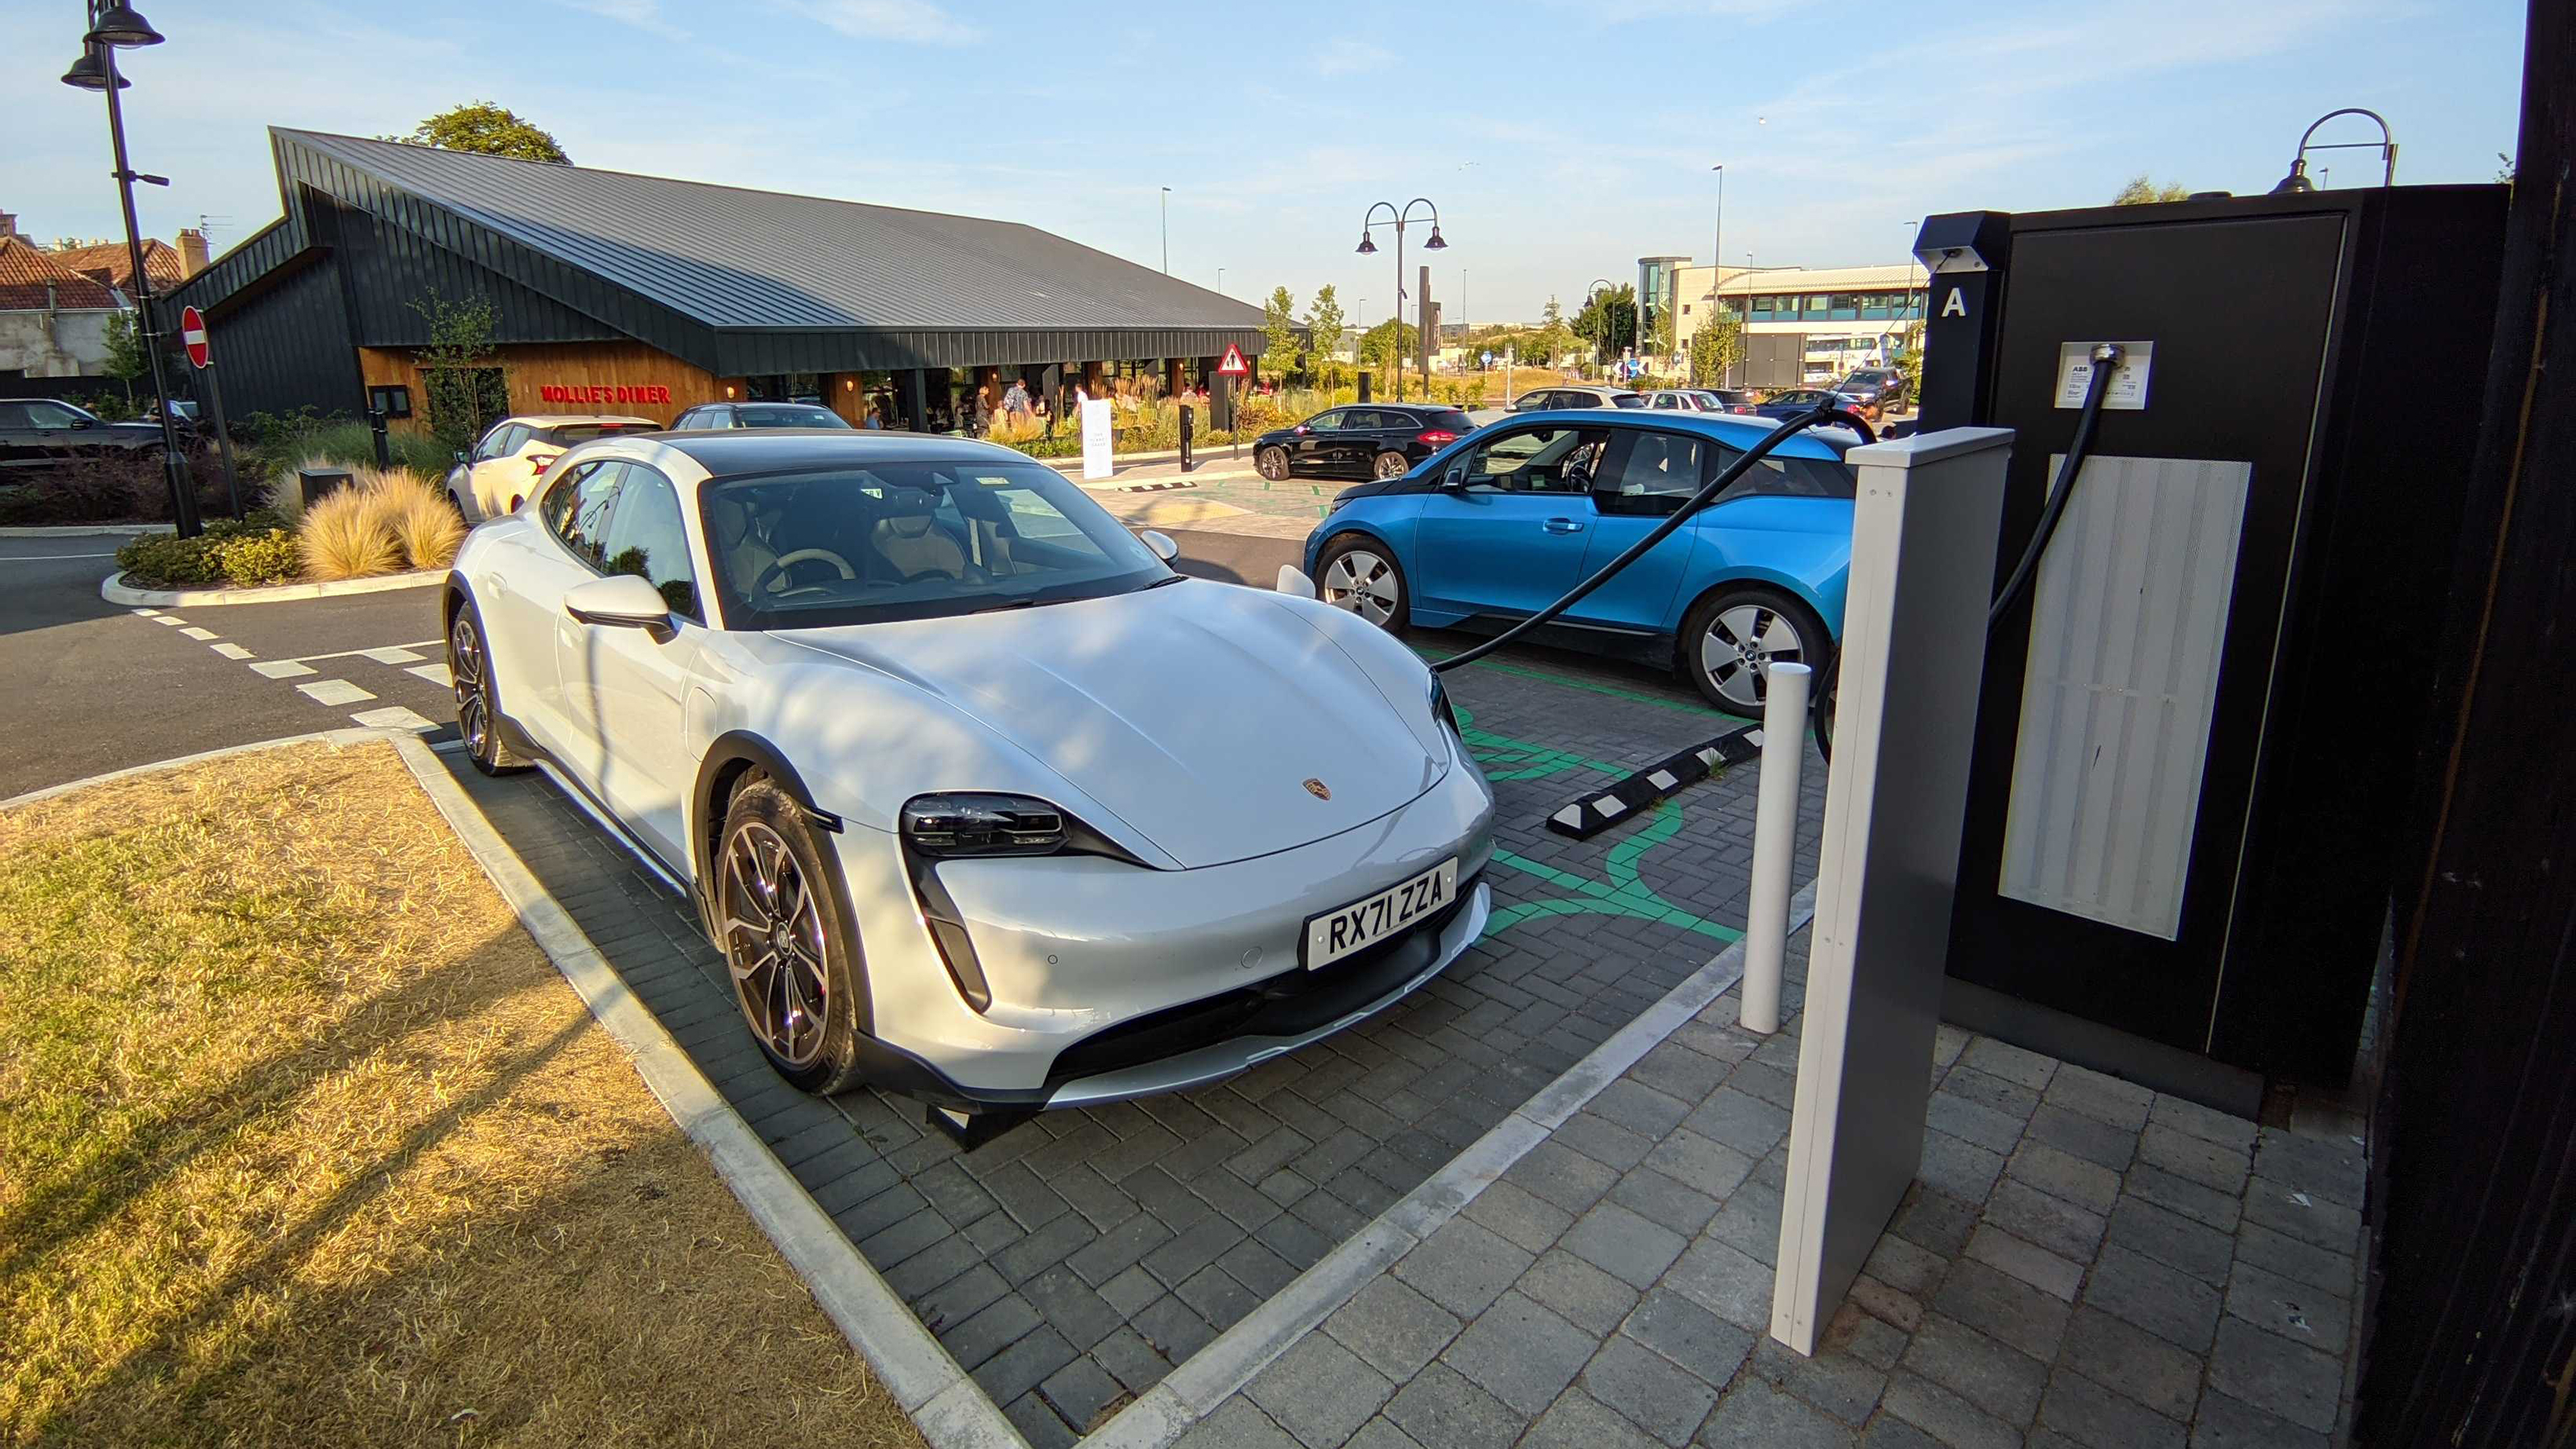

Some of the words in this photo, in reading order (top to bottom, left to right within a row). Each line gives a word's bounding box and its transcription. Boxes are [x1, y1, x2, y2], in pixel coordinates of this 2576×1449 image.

[1941, 287, 1966, 318] A
[540, 385, 614, 404] MOLLIE'S
[616, 385, 672, 404] DINER
[1329, 894, 1393, 955] RX71
[1399, 870, 1442, 923] ZZA
